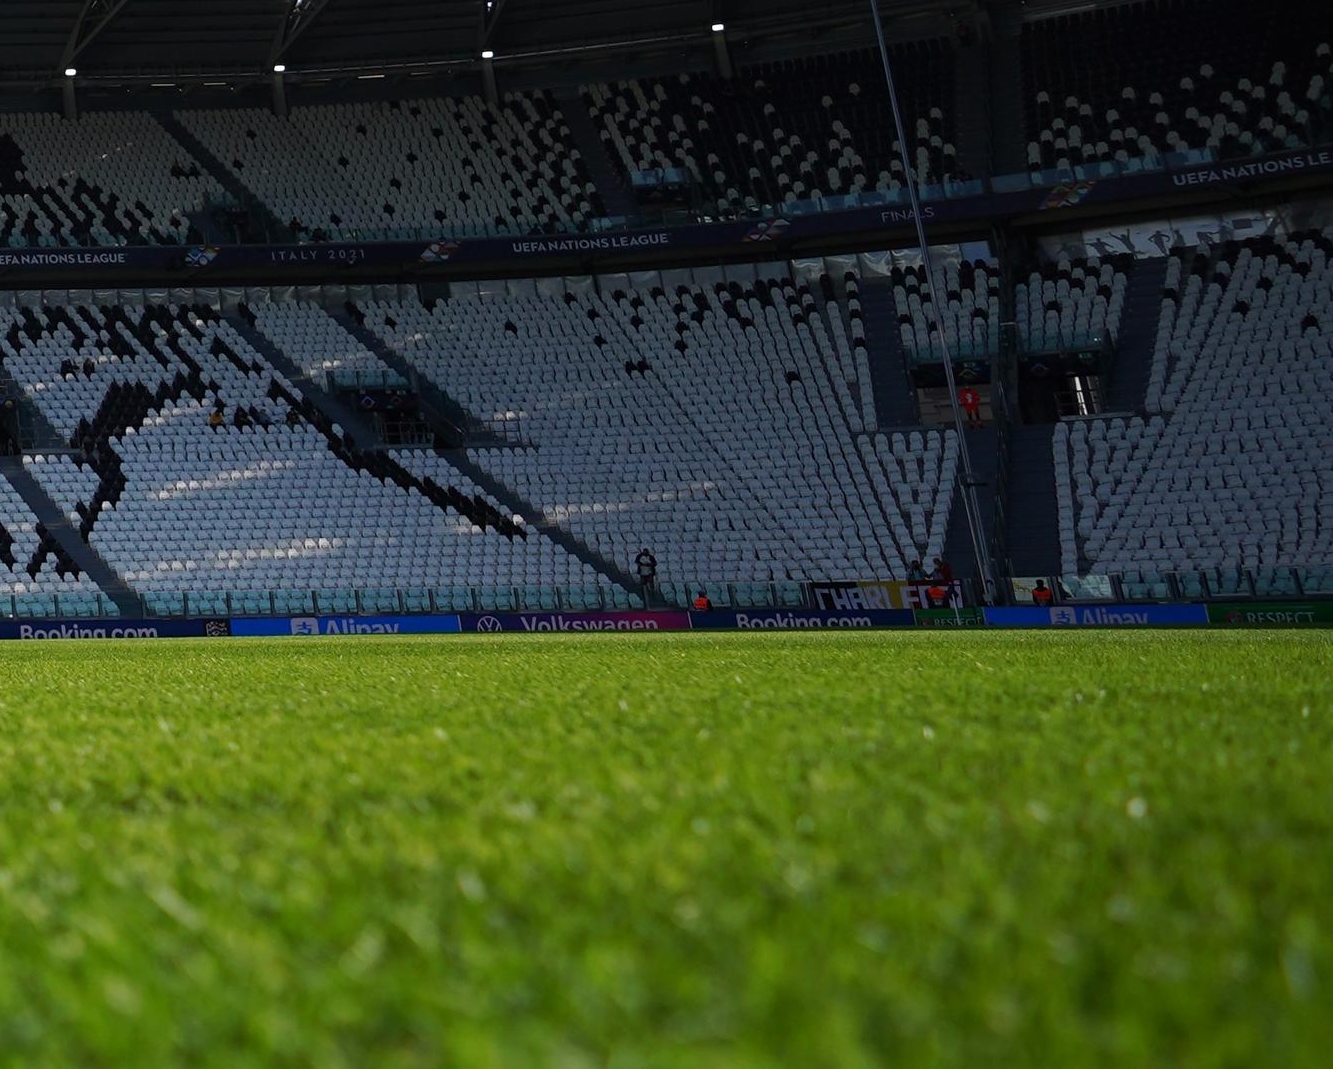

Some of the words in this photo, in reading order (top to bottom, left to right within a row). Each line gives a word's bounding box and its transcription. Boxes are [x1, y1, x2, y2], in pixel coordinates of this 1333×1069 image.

[1173, 169, 1218, 186] UEFA
[1220, 156, 1305, 180] NATIONS
[512, 241, 546, 253] UEFA
[547, 238, 610, 251] NATIONS
[611, 233, 669, 248] LEAGUE
[20, 253, 75, 265] NATIONS
[77, 253, 125, 264] LEAGUE
[271, 250, 317, 261] ITALY
[327, 249, 365, 260] 2021
[735, 611, 872, 629] Bookincom
[19, 623, 159, 639] Bookincom
